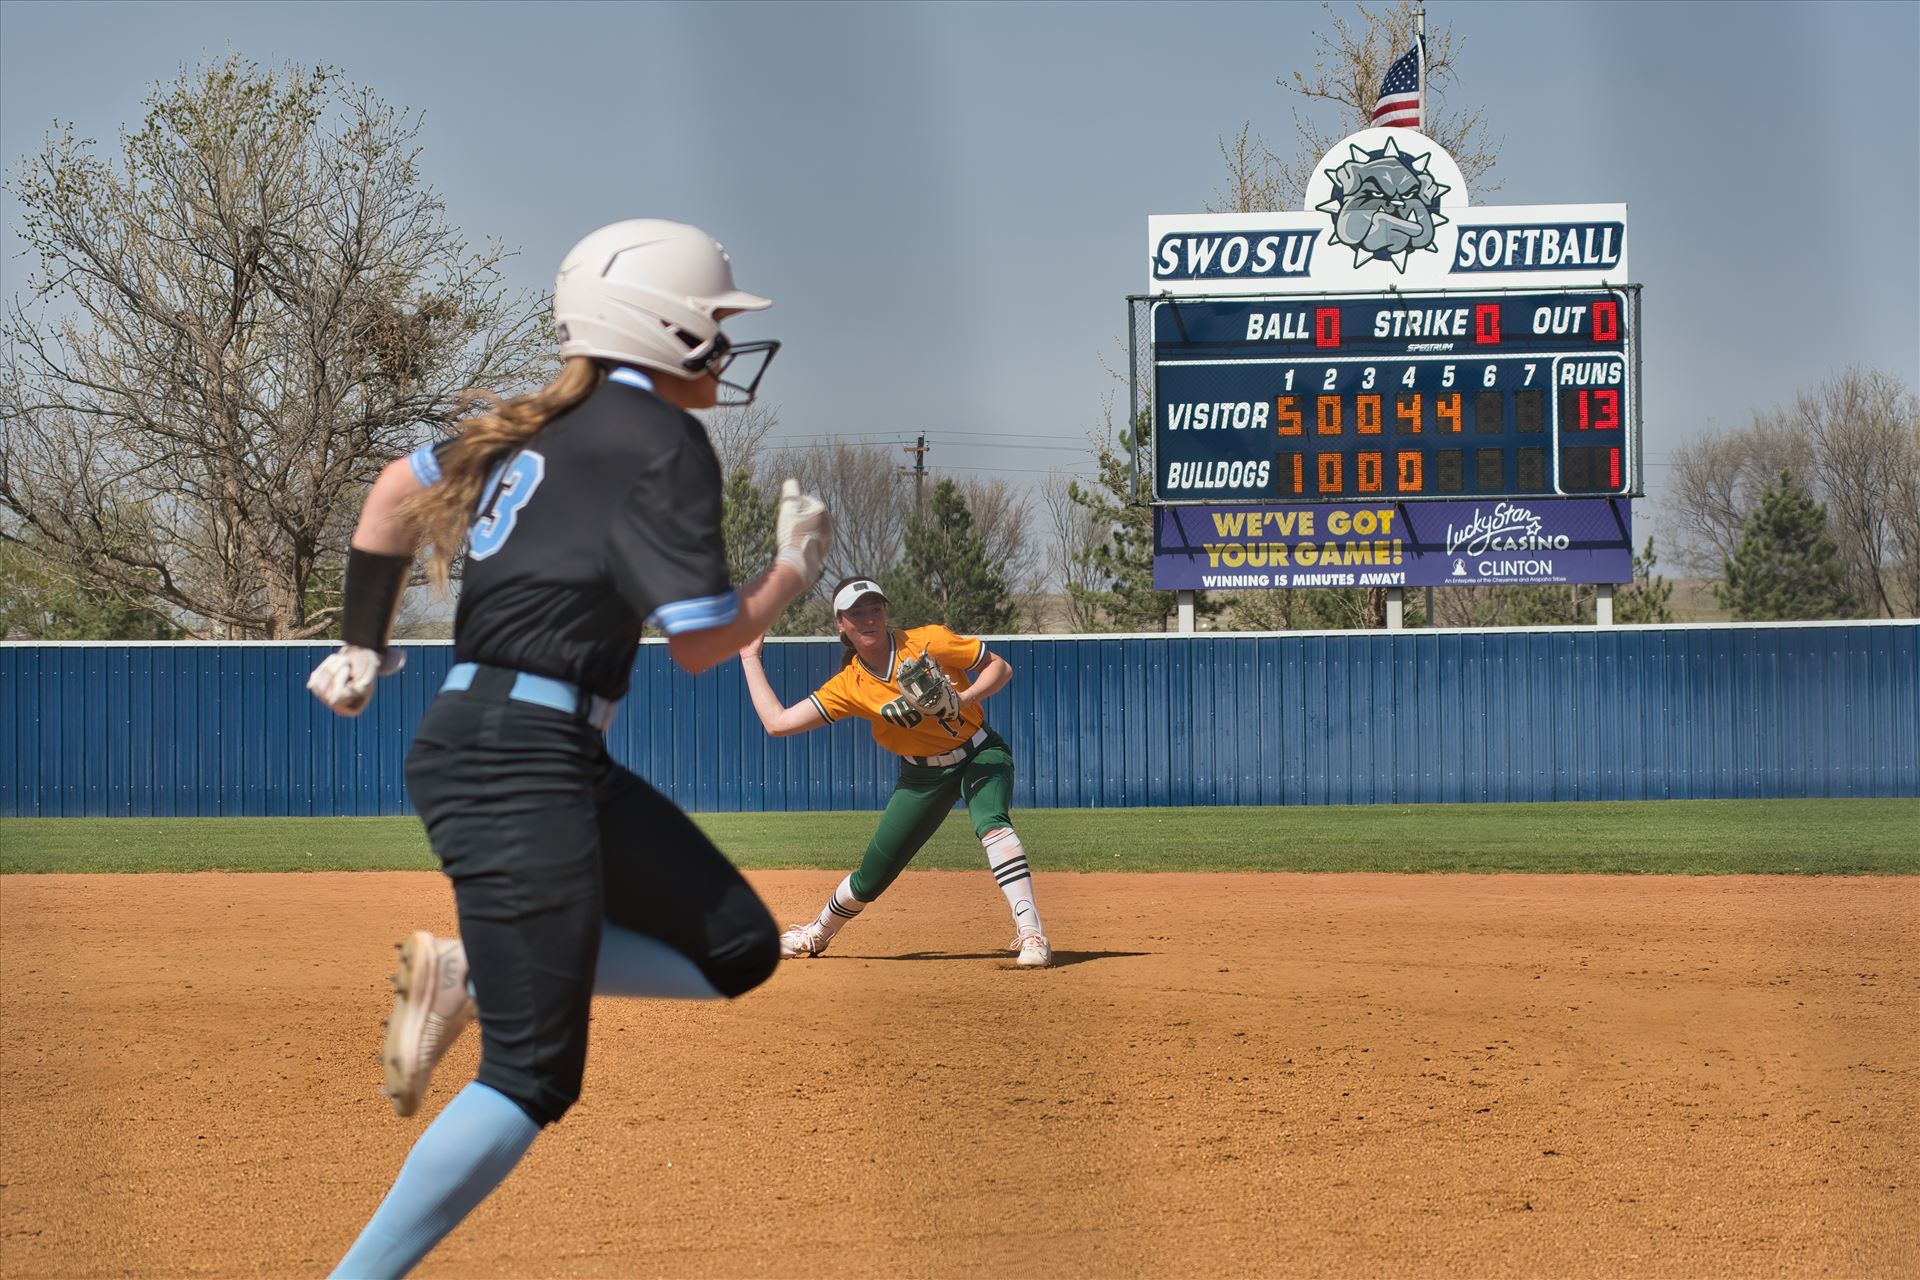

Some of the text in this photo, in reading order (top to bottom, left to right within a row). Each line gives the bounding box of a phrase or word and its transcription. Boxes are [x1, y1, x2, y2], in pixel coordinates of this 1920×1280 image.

[1157, 228, 1619, 275] SWOSU SOFTBALL
[1246, 301, 1617, 347] BALL 0 STRIKE 0 OUT 0
[1284, 363, 1622, 391] 1 2 3 4 5 6 7 RUNS
[1167, 389, 1619, 436] VISITOR 5 0 0 4 4 13
[1167, 448, 1620, 493] BULLDOGS 1 0 0 0 1
[467, 449, 545, 561] 3
[1212, 509, 1395, 537] WE'VE GOT
[1203, 539, 1403, 568] YOUR GAME!
[1491, 535, 1570, 551] CASINO
[1202, 572, 1405, 587] WINNING IS MINUTES AWAY!
[1478, 560, 1553, 576] CLINTON
